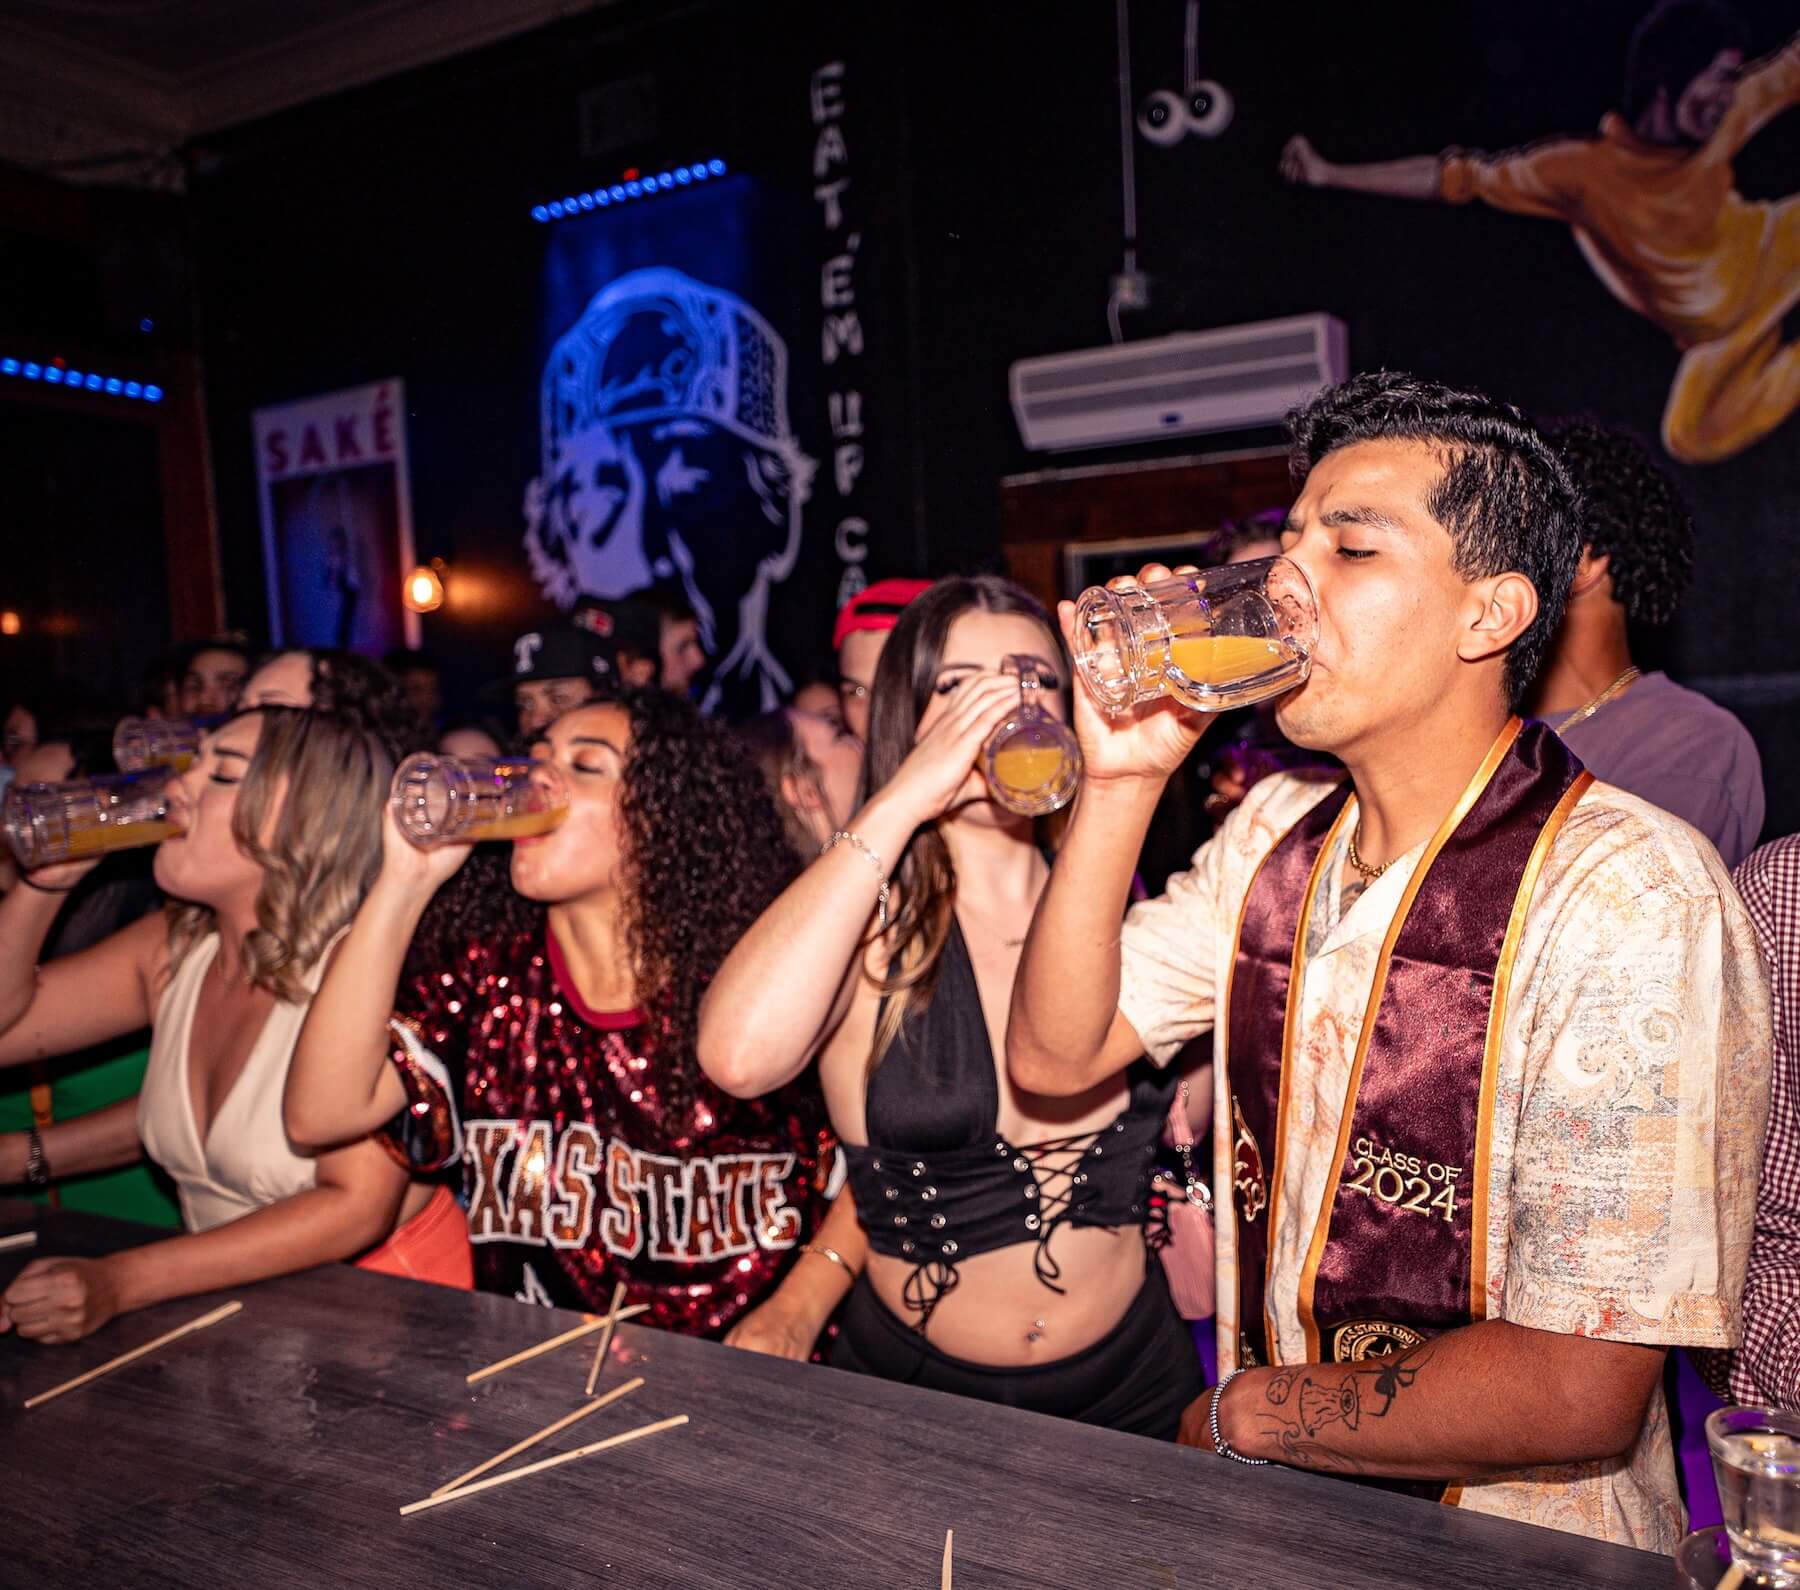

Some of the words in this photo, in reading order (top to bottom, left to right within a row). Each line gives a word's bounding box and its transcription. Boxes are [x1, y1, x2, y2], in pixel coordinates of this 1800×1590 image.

[810, 61, 849, 229] EAT
[265, 383, 393, 473] SAKÉ
[828, 391, 864, 496] UP
[835, 516, 869, 610] CA
[463, 1119, 603, 1250] XAS
[600, 1136, 802, 1262] STATE
[1344, 1157, 1458, 1222] 2024
[1356, 1138, 1421, 1175] CLASS
[1427, 1163, 1462, 1185] OF
[1354, 1323, 1390, 1335] STATE
